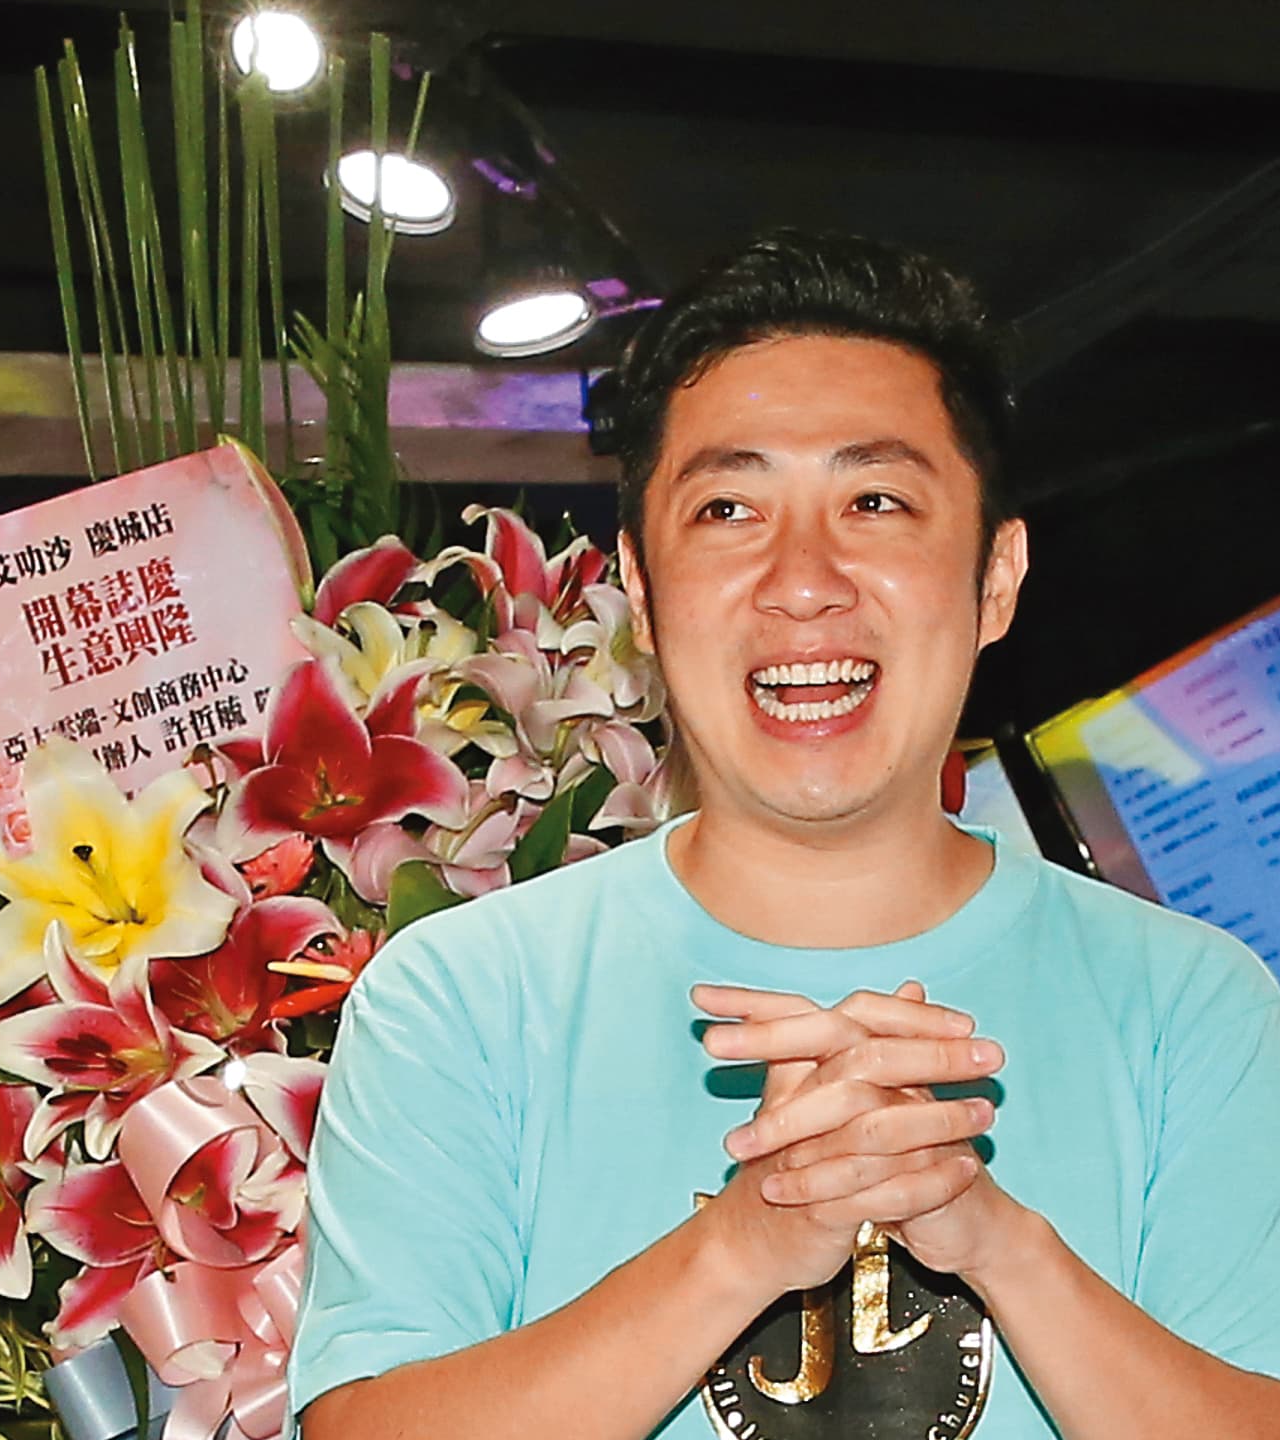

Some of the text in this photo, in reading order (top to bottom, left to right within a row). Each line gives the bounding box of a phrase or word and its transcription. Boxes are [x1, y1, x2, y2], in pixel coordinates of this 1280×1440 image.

[84, 502, 174, 558] 慶城店
[21, 555, 182, 645] 開幕誌慶
[41, 602, 198, 693] 生意興隆
[91, 733, 152, 774] 辦人
